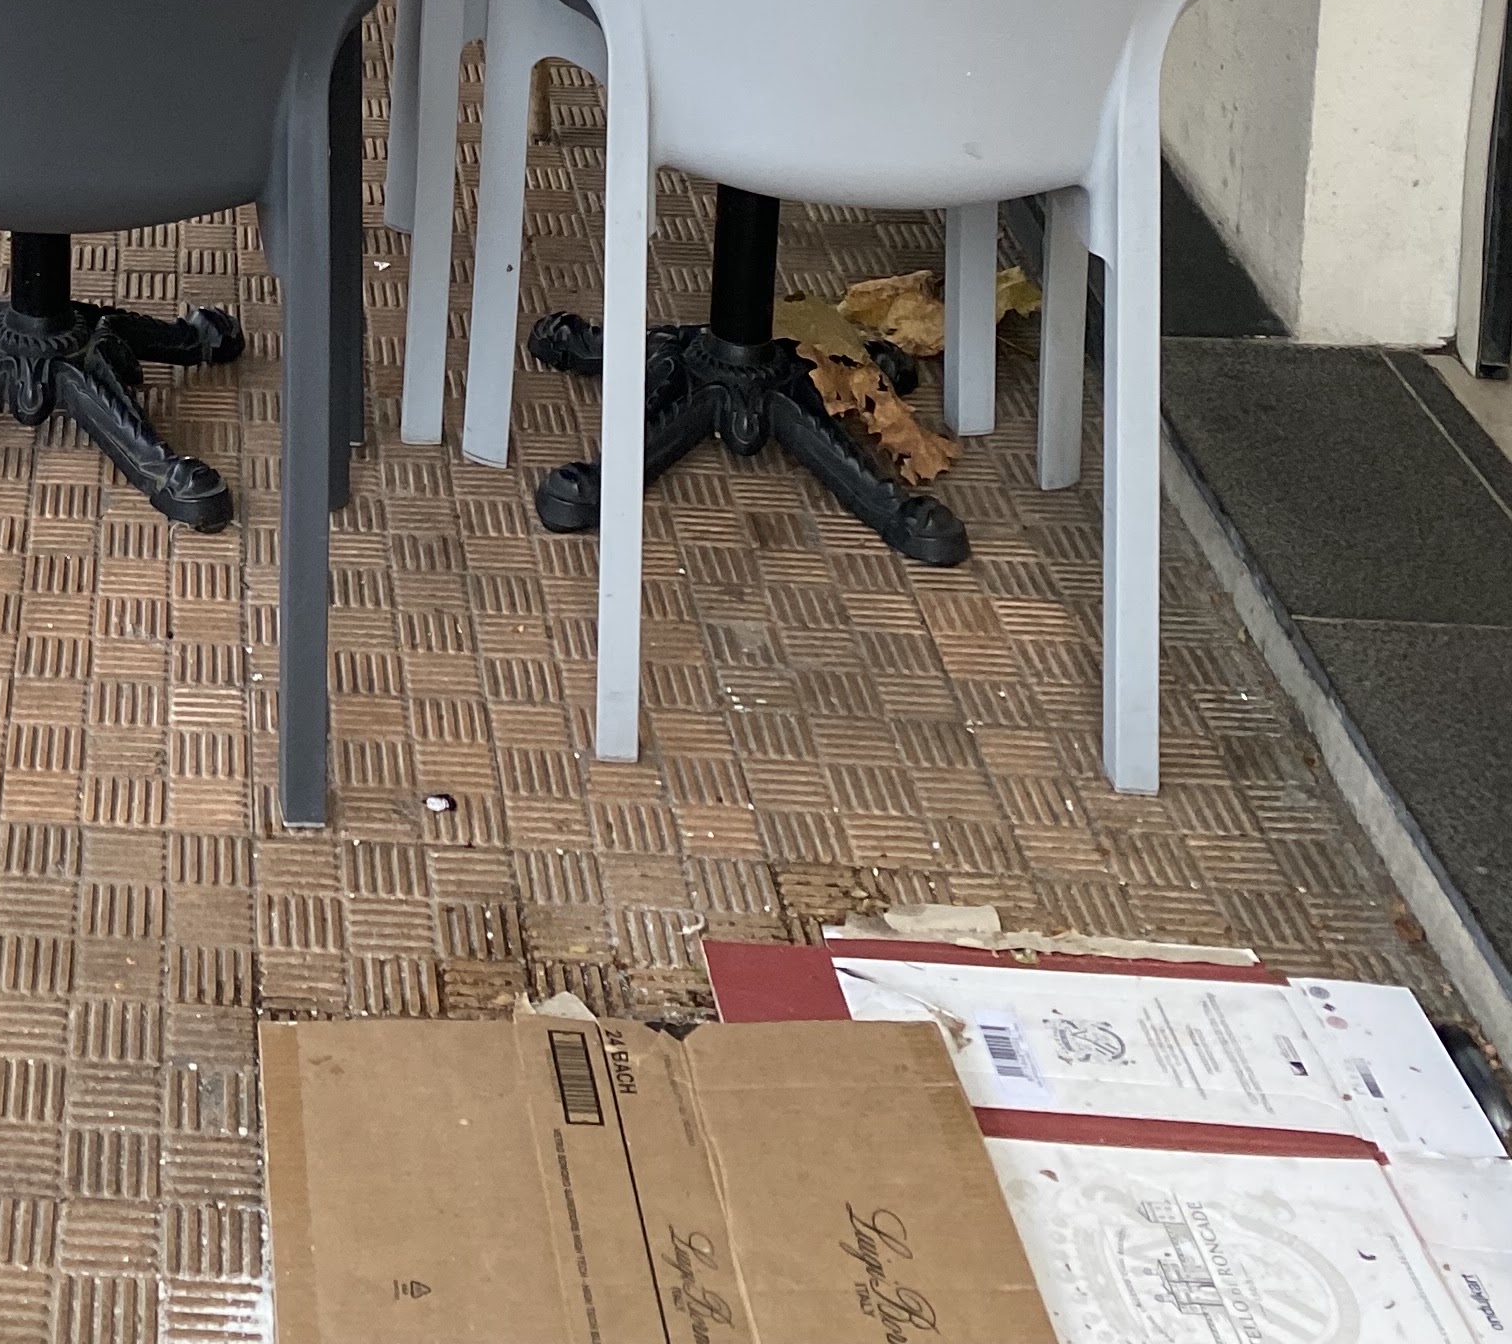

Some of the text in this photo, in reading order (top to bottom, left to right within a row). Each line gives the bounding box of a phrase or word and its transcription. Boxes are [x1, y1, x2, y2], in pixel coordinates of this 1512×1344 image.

[605, 1030, 637, 1094] 24 BACH
[663, 1224, 718, 1288] Luigi
[839, 1202, 913, 1286] Luigi
[1187, 1200, 1234, 1278] RONCADE
[854, 1282, 875, 1317] ITALY
